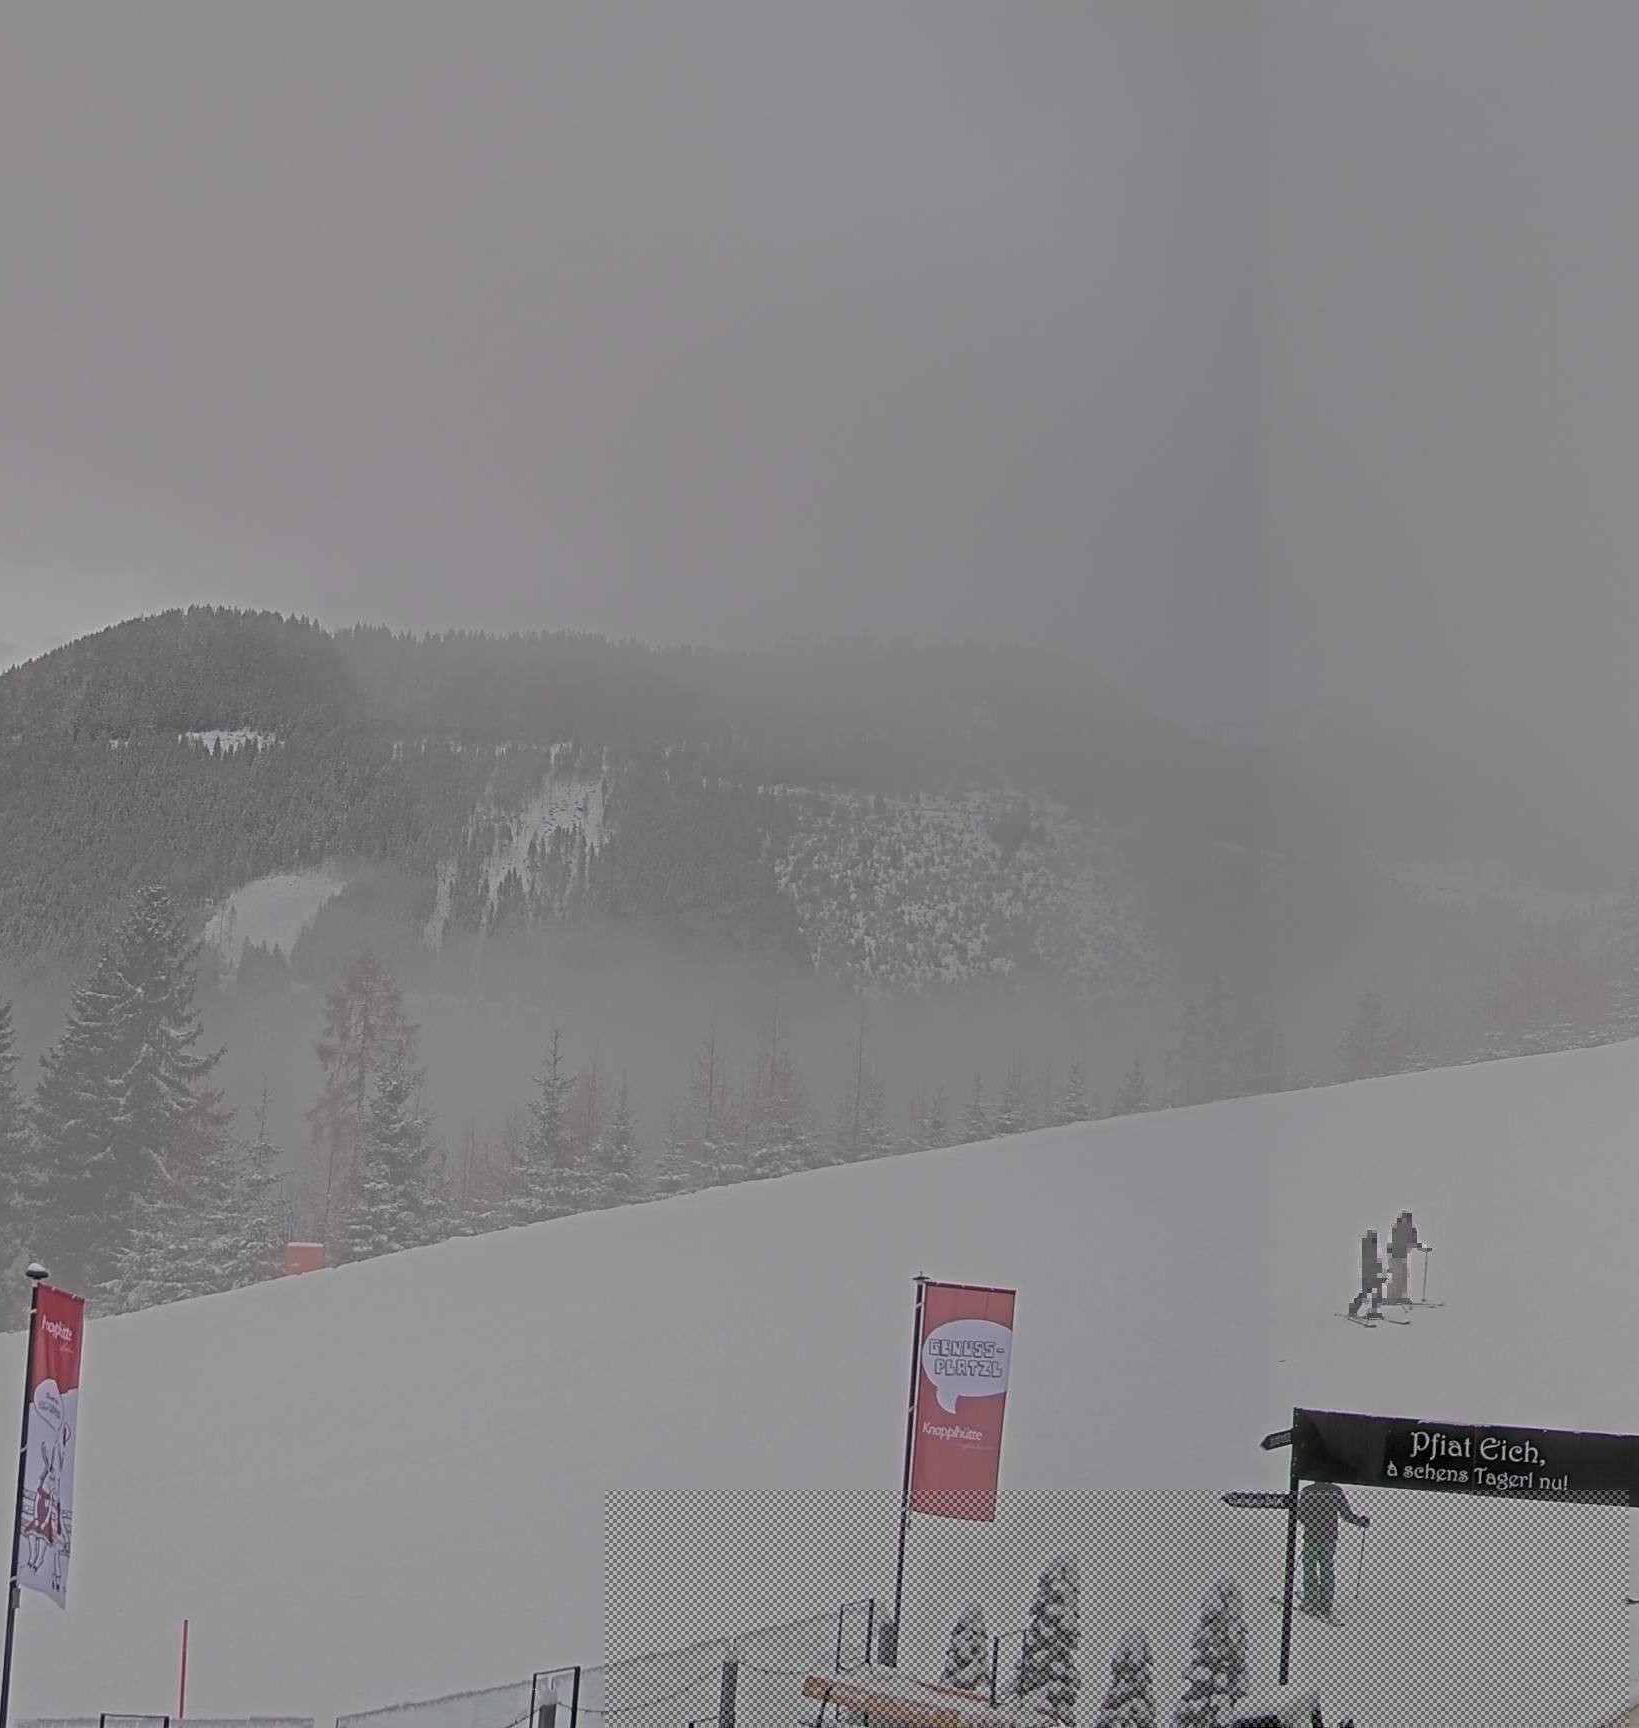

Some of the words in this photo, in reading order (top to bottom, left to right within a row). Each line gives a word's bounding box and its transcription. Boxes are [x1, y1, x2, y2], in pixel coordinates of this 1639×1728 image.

[928, 1338, 1005, 1359] GENUSS-
[934, 1358, 1003, 1378] PLATZL
[1410, 1431, 1471, 1460] Pfiat
[1479, 1436, 1546, 1467] Eich,
[1403, 1463, 1469, 1483] schens
[1473, 1466, 1534, 1490] Tagerl
[1539, 1474, 1569, 1491] nu!
